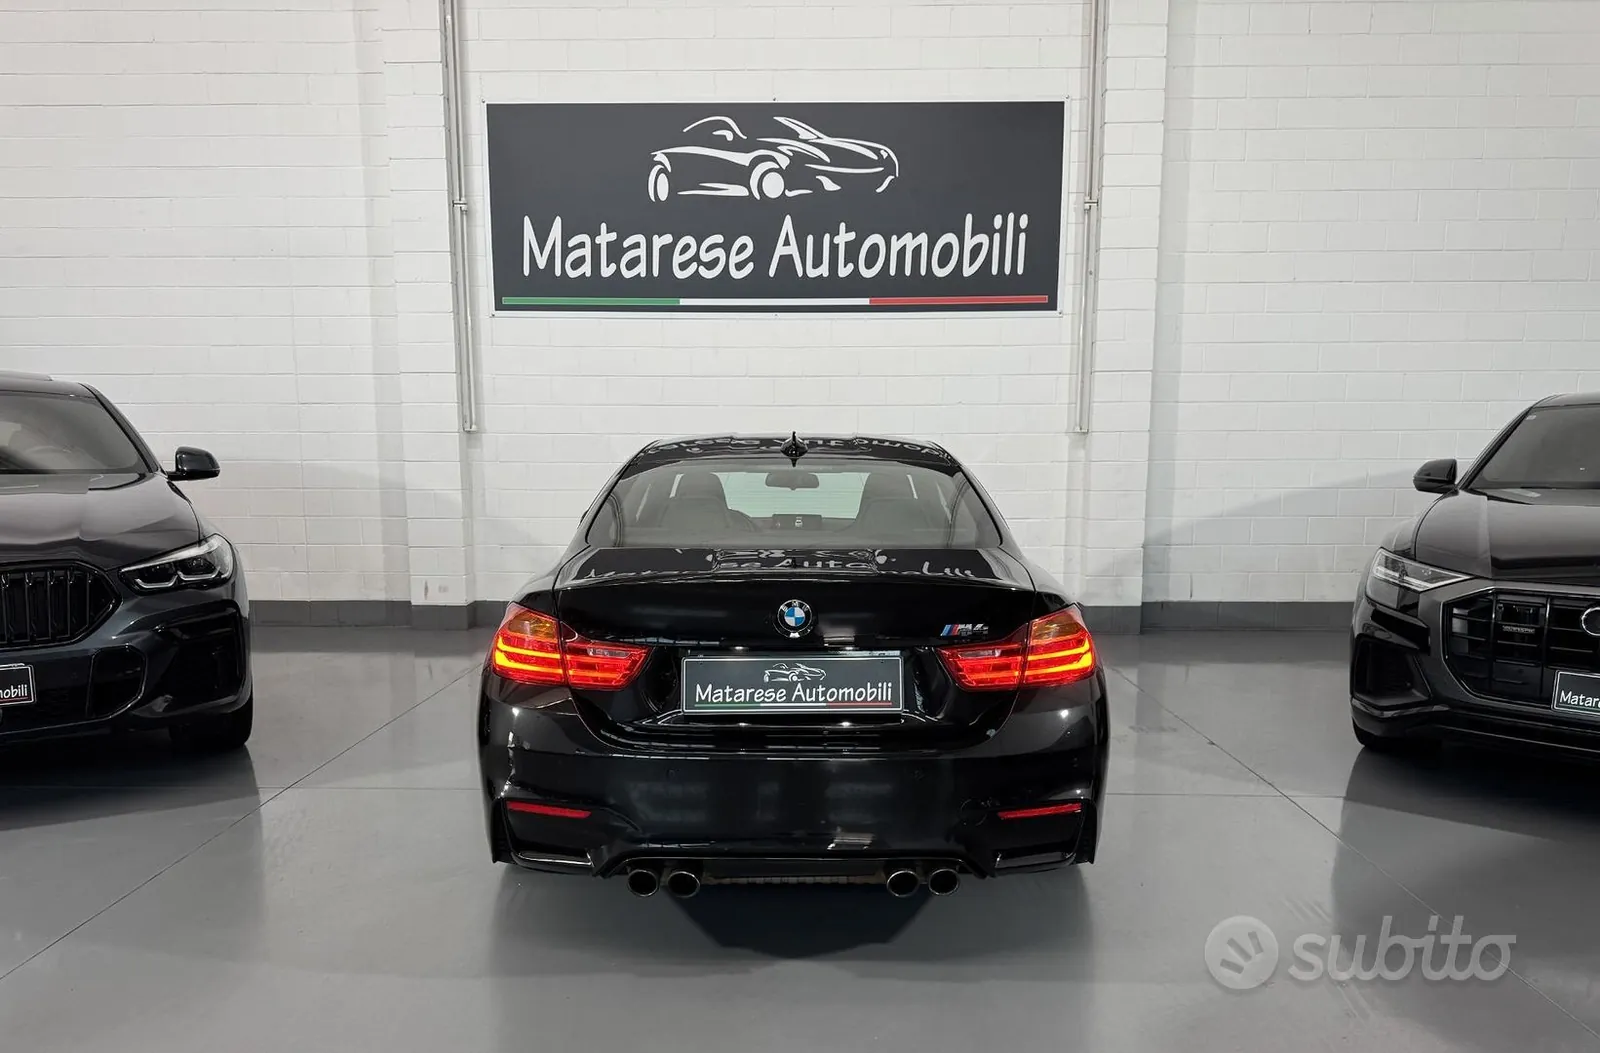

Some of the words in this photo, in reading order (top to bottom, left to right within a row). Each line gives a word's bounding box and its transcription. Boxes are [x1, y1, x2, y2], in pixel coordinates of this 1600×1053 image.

[524, 216, 753, 279] Matarese
[769, 212, 1028, 278] Automobili
[696, 684, 786, 702] Matarese
[792, 682, 891, 701] Automobili
